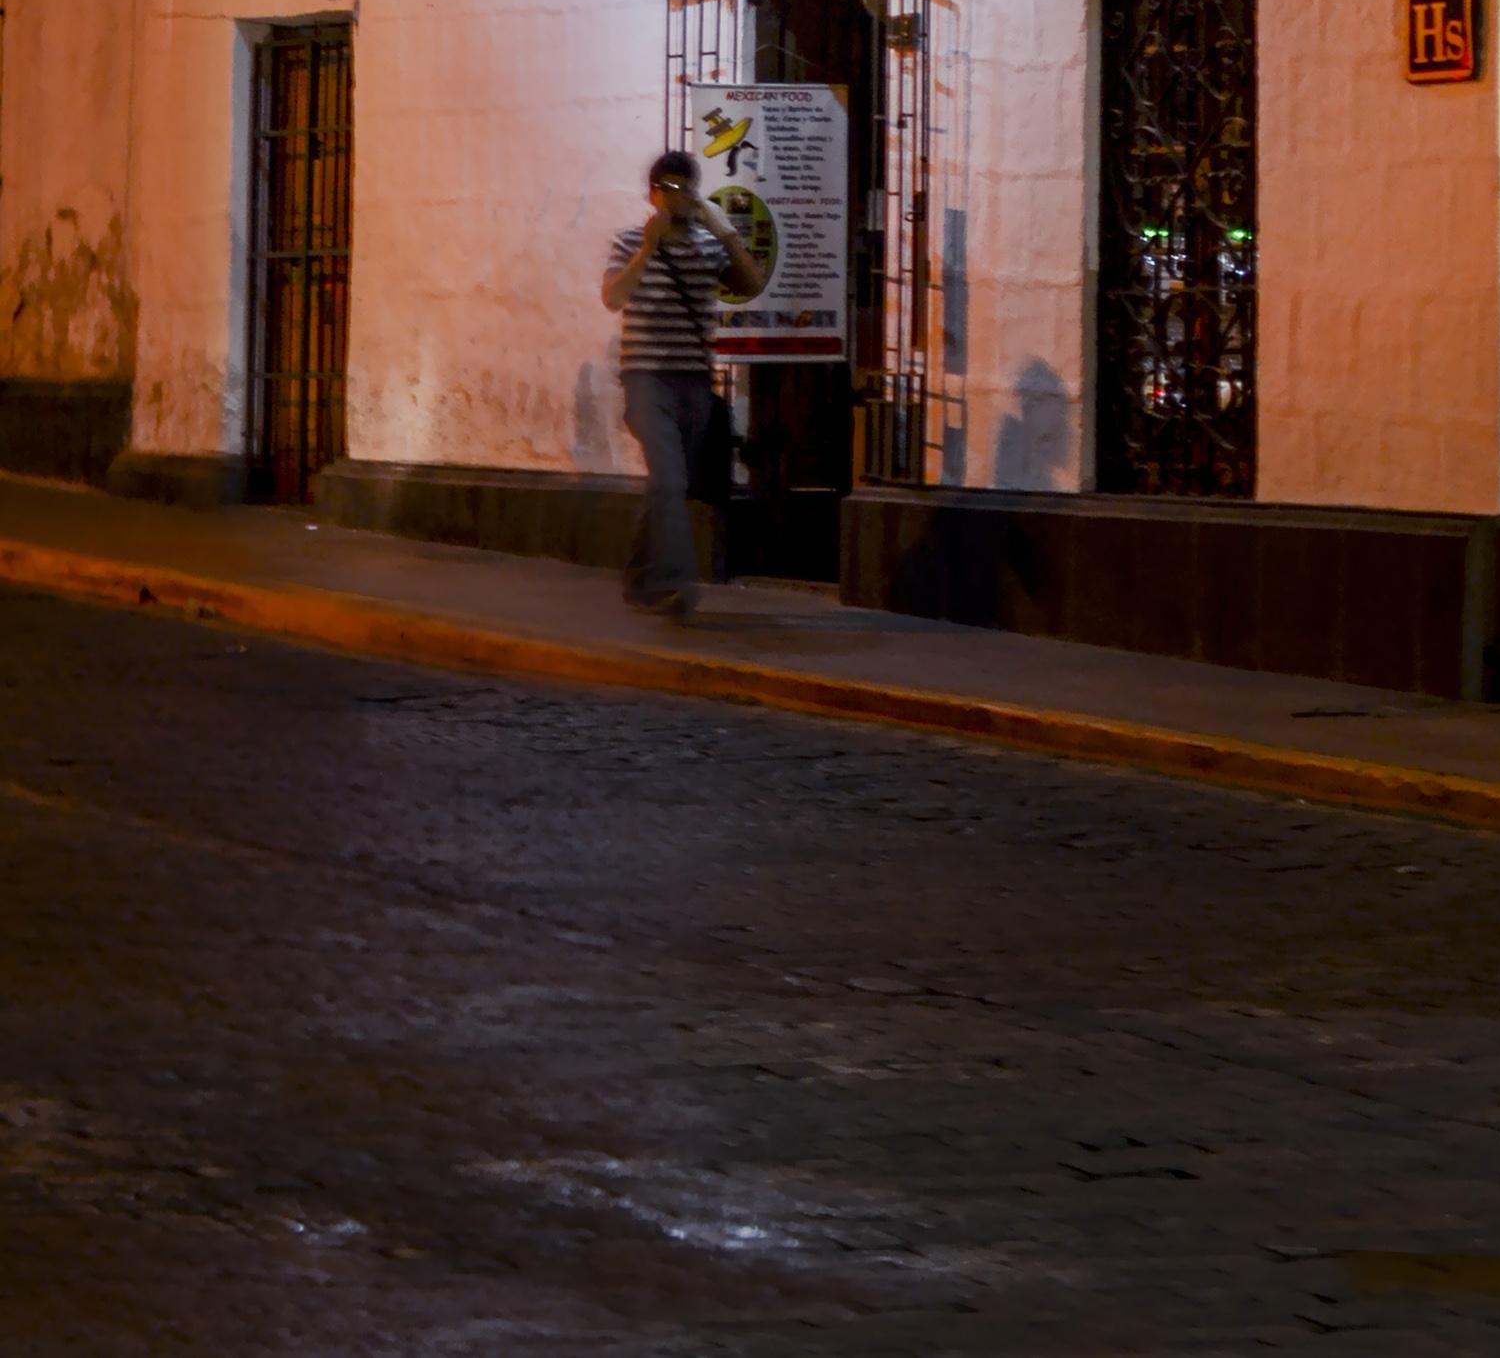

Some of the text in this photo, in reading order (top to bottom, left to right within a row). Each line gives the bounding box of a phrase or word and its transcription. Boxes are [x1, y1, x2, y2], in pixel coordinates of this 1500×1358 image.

[1412, 1, 1466, 66] Hs
[726, 91, 813, 102] MEXICAN FOOD
